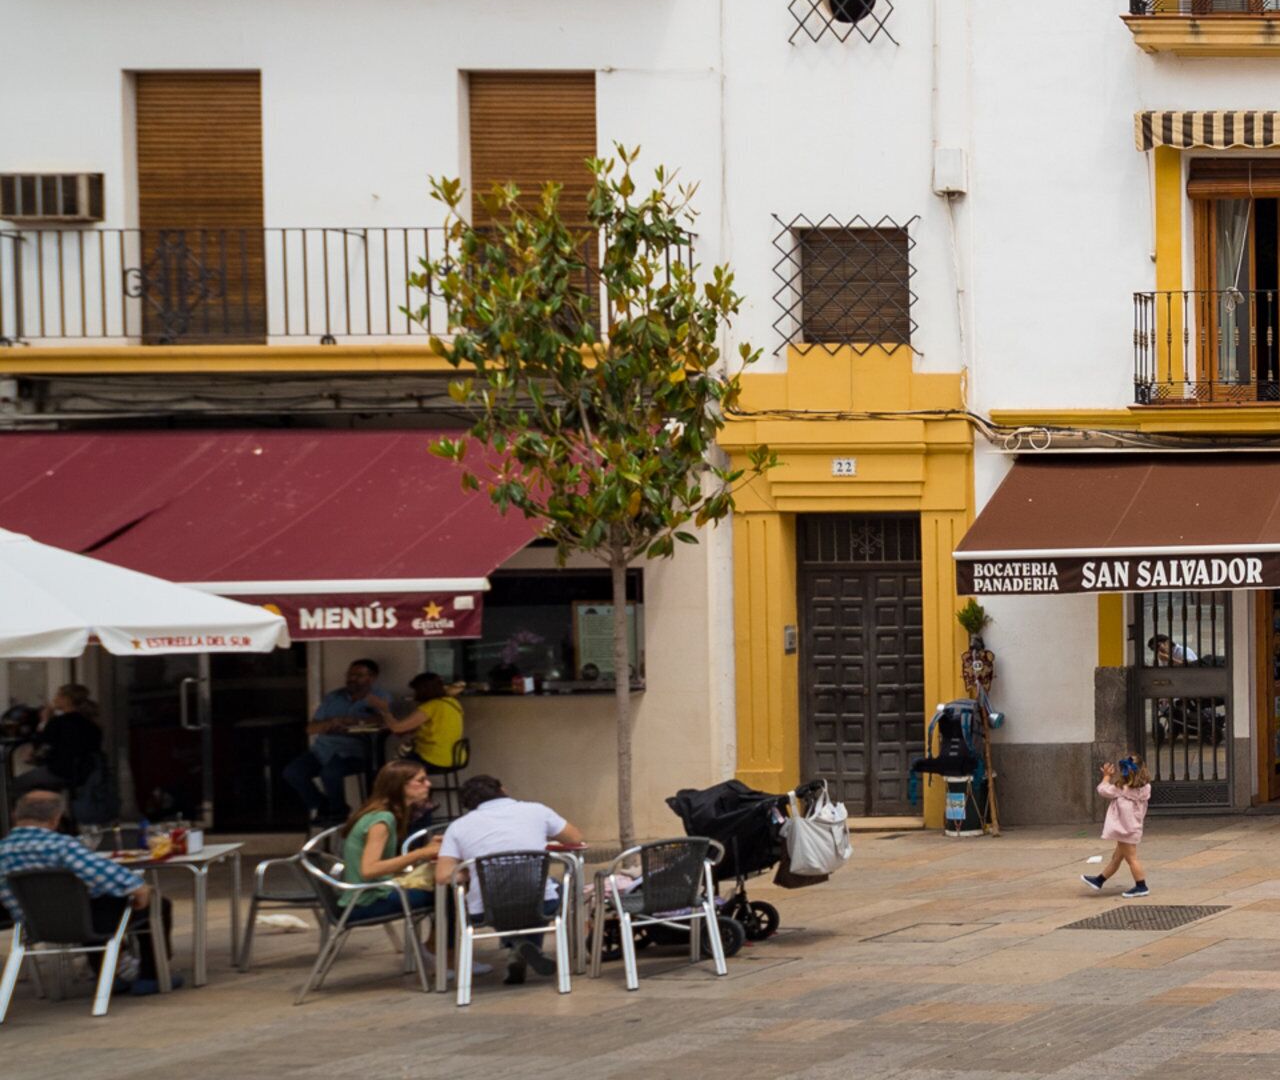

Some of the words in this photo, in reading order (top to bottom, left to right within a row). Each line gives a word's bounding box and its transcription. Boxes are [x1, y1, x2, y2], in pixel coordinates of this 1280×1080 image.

[836, 461, 852, 472] 22
[973, 563, 1058, 577] BOCATERIA
[1081, 561, 1130, 589] SAN
[1136, 558, 1264, 587] SALVADOR
[974, 577, 1059, 592] PANADERIA
[300, 601, 398, 630] MENÚS
[145, 635, 203, 648] ESTRELLA
[206, 635, 226, 647] DEL
[229, 635, 251, 646] SUR
